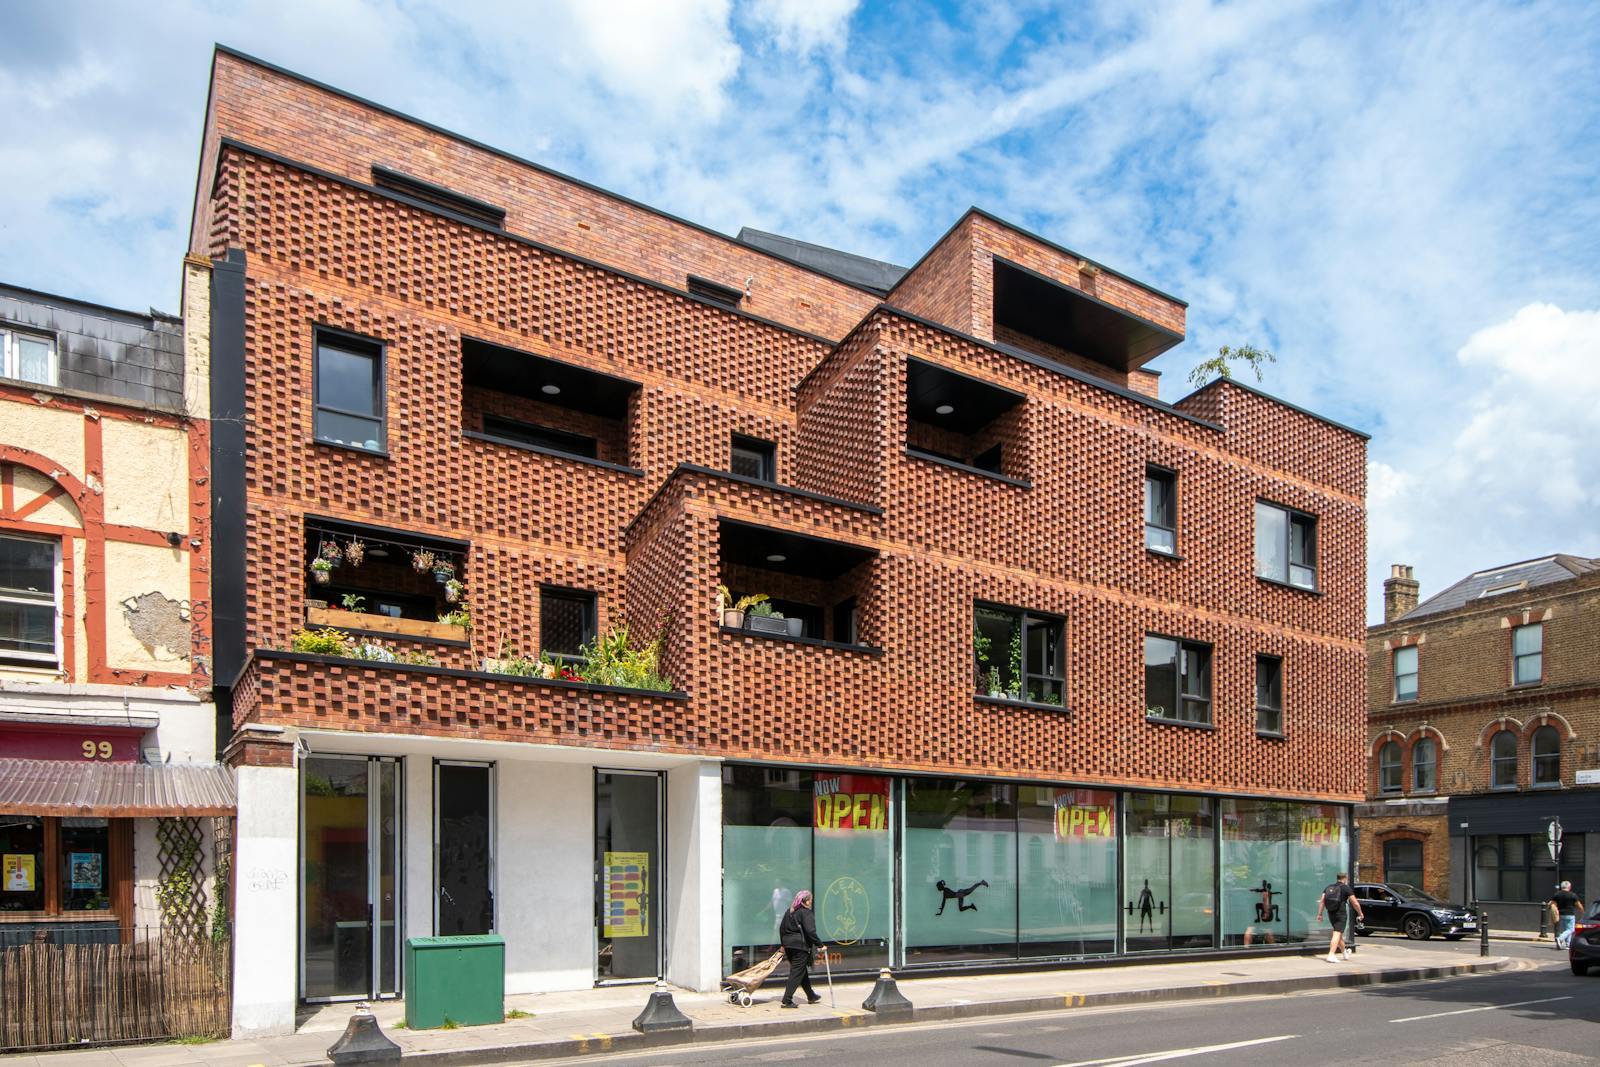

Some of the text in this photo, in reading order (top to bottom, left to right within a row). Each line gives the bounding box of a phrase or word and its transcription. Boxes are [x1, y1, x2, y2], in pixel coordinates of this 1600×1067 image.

[82, 740, 113, 759] 99
[814, 778, 840, 796] NOW
[816, 793, 887, 833] OPEN
[1058, 803, 1111, 838] OPEN
[1302, 817, 1341, 846] OPEN
